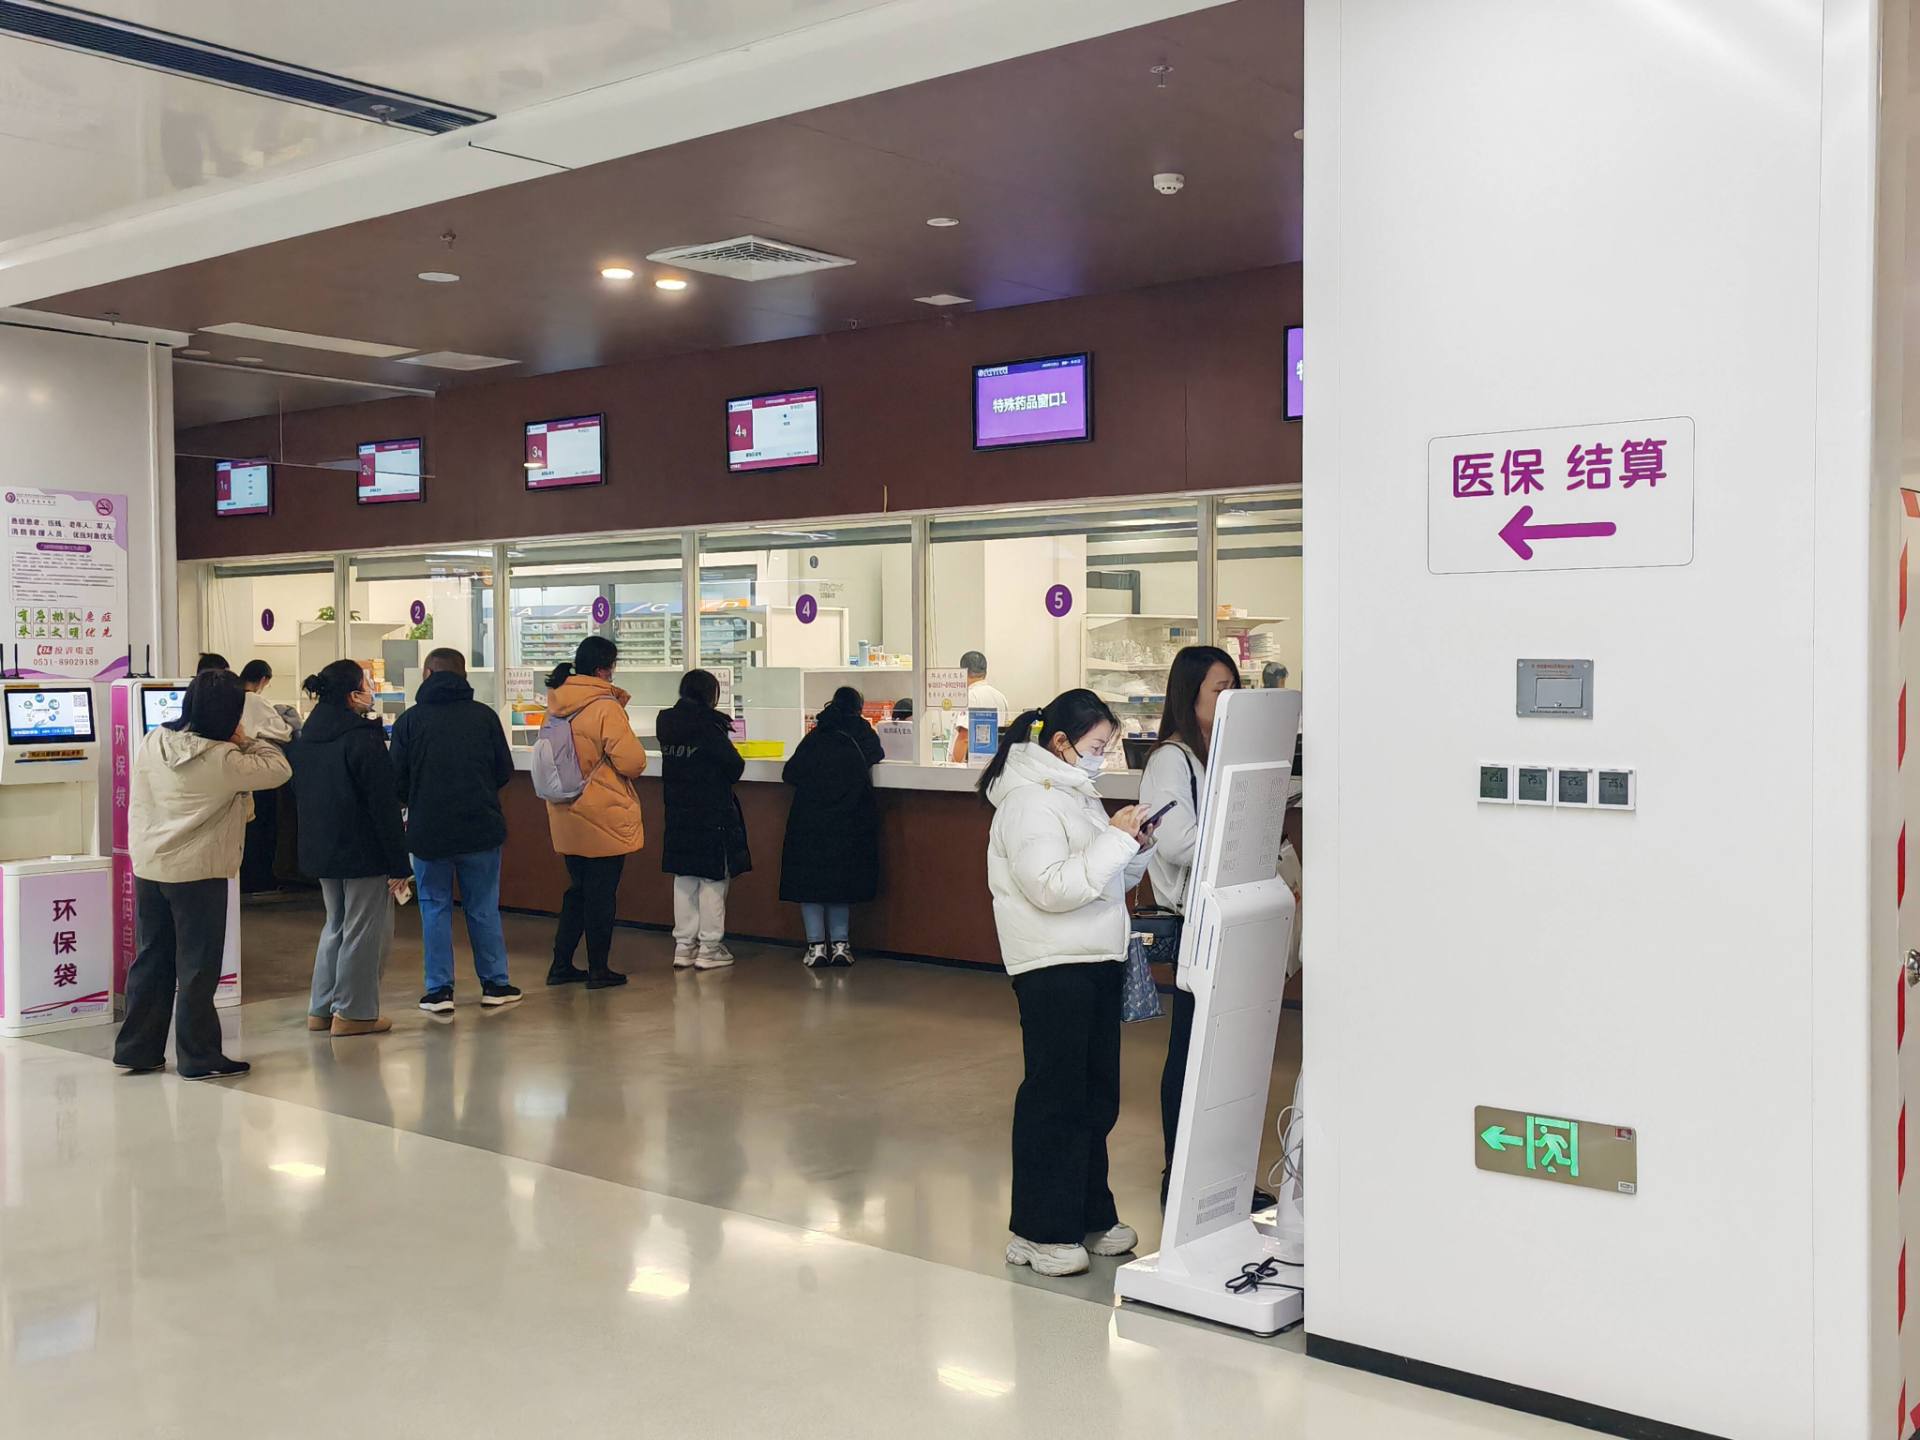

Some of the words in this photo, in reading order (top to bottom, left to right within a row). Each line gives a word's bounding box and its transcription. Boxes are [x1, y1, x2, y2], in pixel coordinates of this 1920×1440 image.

[992, 391, 1068, 414] 特殊药品窗口1
[1452, 447, 1545, 499] 医保
[1566, 437, 1668, 491] 结算
[597, 603, 605, 617] 3
[801, 600, 811, 619] 4
[1053, 591, 1064, 610] 5
[17, 608, 81, 623] 有序排队
[85, 610, 113, 623] 急症
[414, 605, 421, 619] 2
[85, 626, 113, 638] 优先
[114, 724, 126, 808] 环保袋
[52, 897, 79, 988] 环保袋
